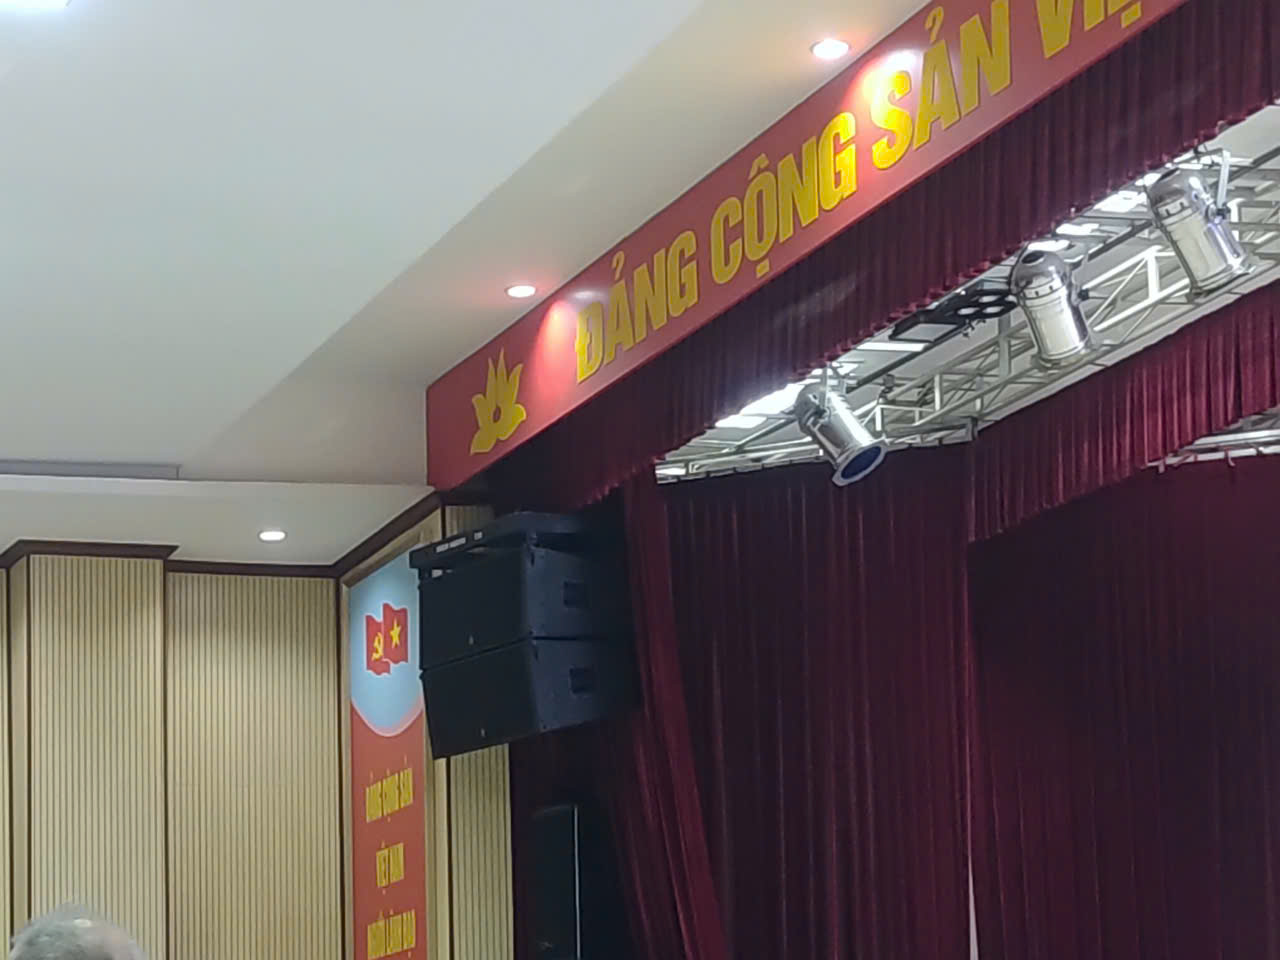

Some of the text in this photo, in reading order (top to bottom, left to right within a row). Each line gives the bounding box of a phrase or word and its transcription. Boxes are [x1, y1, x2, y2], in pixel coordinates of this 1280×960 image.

[574, 0, 1012, 385] ĐẢNG CỘNG SẢN
